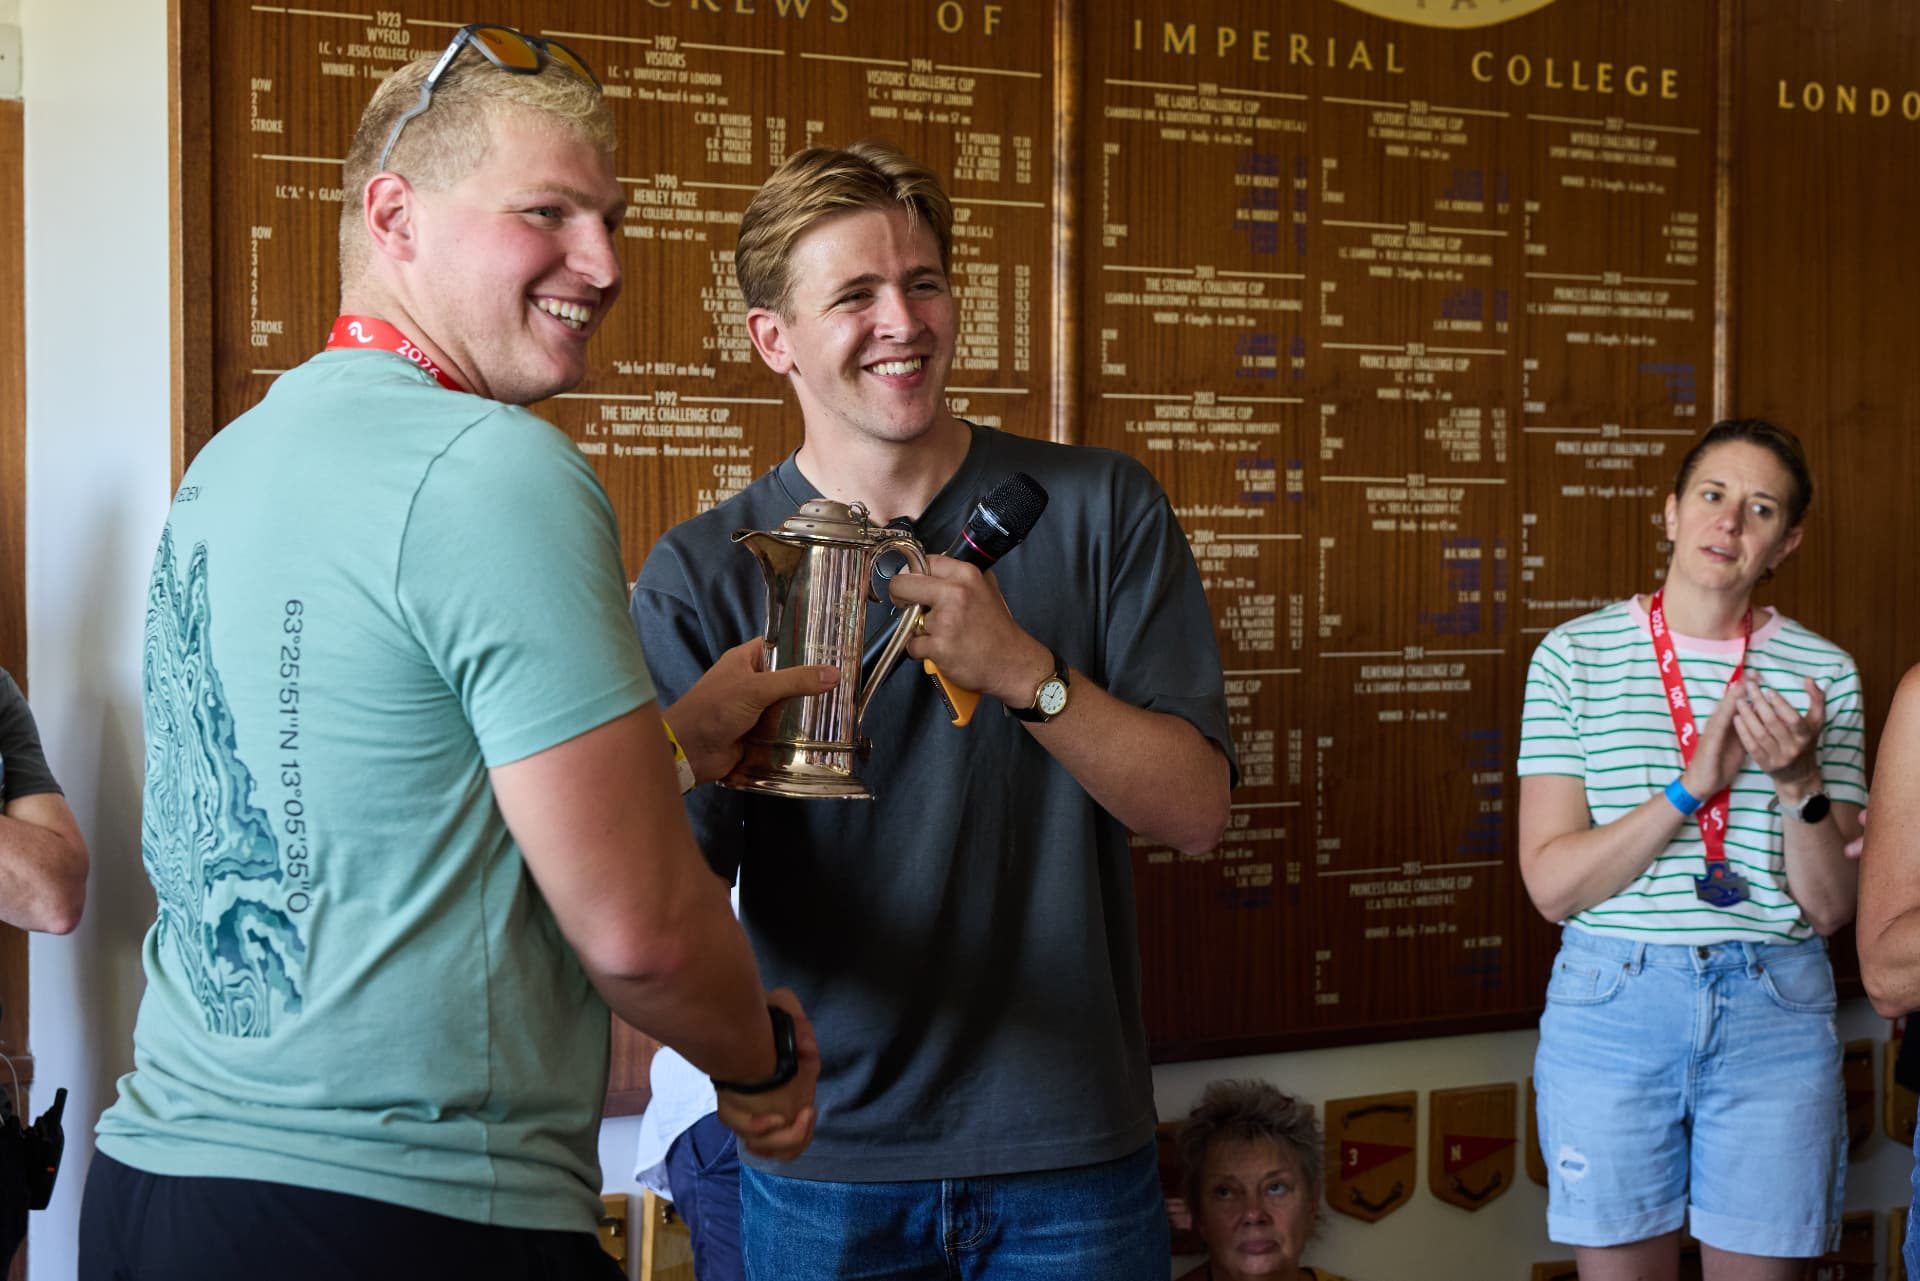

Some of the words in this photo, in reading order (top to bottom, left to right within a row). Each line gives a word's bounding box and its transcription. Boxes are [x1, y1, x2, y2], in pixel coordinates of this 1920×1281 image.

[376, 11, 402, 28] 1923
[937, 1, 1002, 35] OF
[347, 45, 372, 58] JESUS
[373, 47, 408, 62] COLLEGE
[644, 50, 686, 68] VISITORS
[1134, 19, 1405, 73] IMPERIAL
[1471, 50, 1679, 99] COLLEGE
[321, 62, 355, 78] WINNER
[633, 67, 677, 83] UNIVERSITY
[690, 72, 722, 86] LONDON
[251, 78, 272, 91] BOW
[908, 73, 956, 91] CHALLENGE
[958, 77, 976, 92] CUP
[602, 84, 632, 98] WINNER
[250, 119, 283, 133] STROKE
[633, 188, 669, 205] HENLEY
[671, 190, 698, 207] PRIZE
[641, 206, 674, 220] COLLEGE
[251, 226, 272, 239] BOW
[623, 225, 654, 239] WINNER
[251, 320, 283, 334] STROKE
[251, 334, 269, 347] COX
[655, 390, 678, 406] 1992
[601, 405, 619, 421] THE
[620, 406, 656, 421] TEMPLE
[657, 407, 709, 423] CHALLENGE
[711, 408, 730, 423] CUP
[611, 423, 641, 437] TRINITY
[642, 424, 674, 437] COLLEGE
[675, 425, 703, 438] DUBLIN
